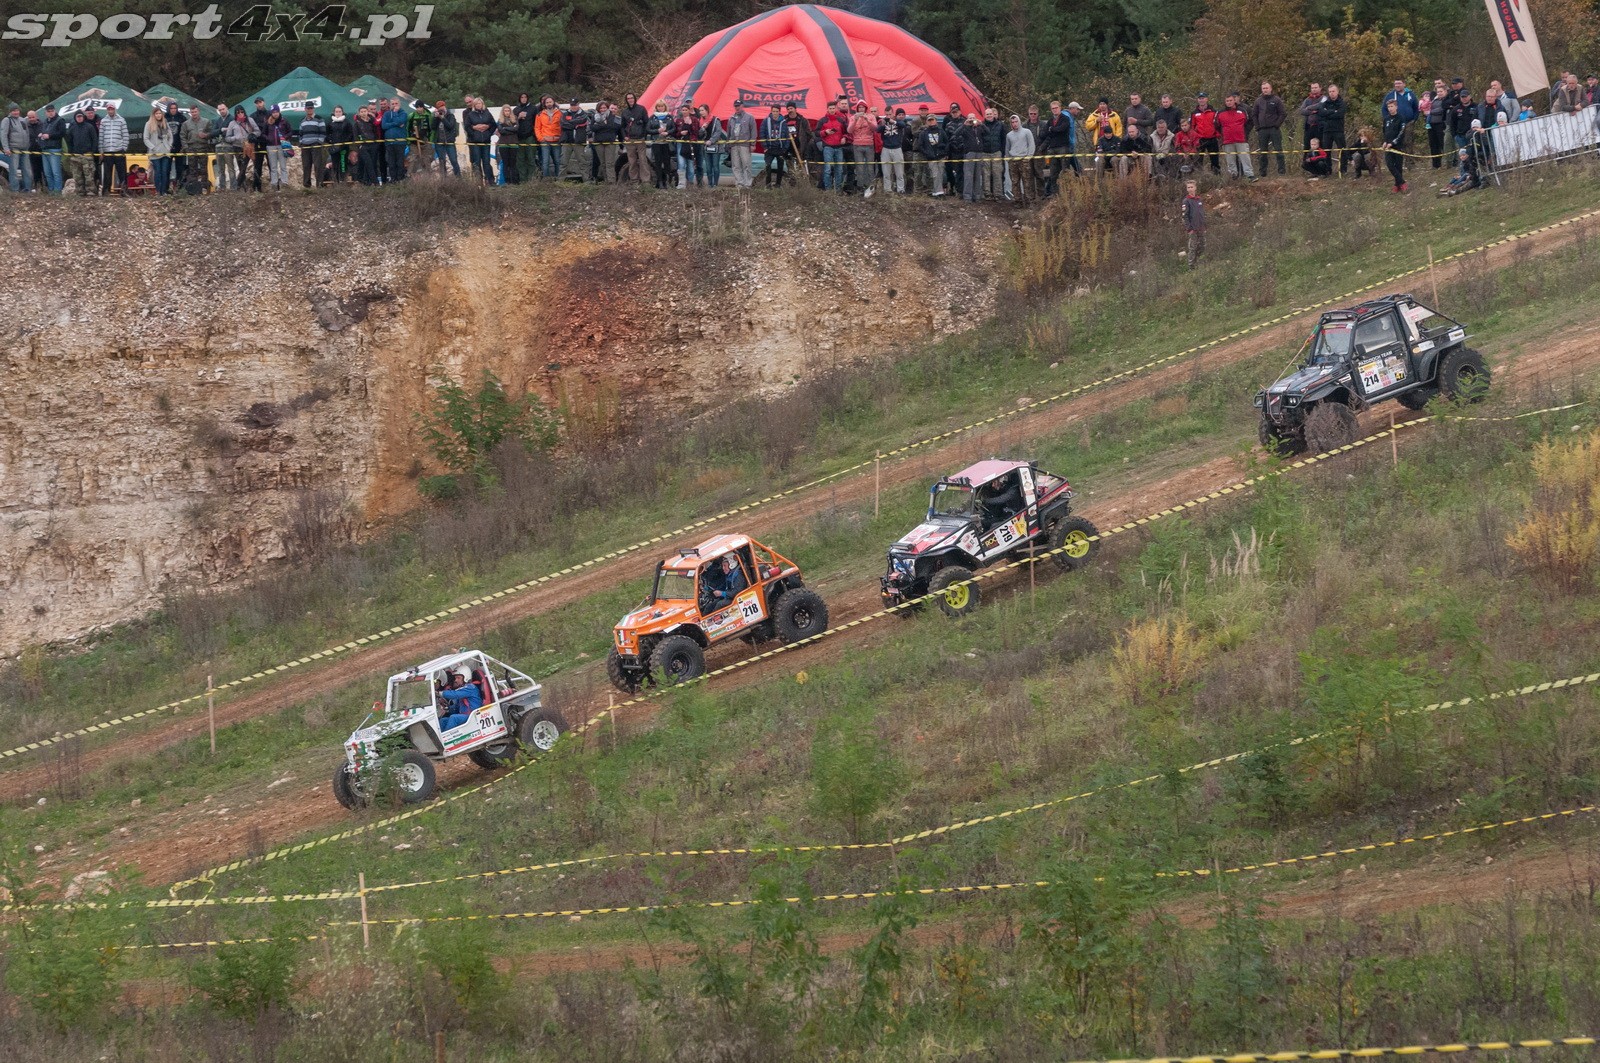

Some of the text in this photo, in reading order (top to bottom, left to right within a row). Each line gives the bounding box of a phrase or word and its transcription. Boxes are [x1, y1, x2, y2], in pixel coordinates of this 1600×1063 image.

[743, 93, 803, 101] DRAGON
[882, 88, 926, 98] DRAGON
[1364, 374, 1379, 387] 214
[999, 525, 1013, 543] 219
[742, 603, 759, 617] 218
[479, 716, 496, 730] 201
